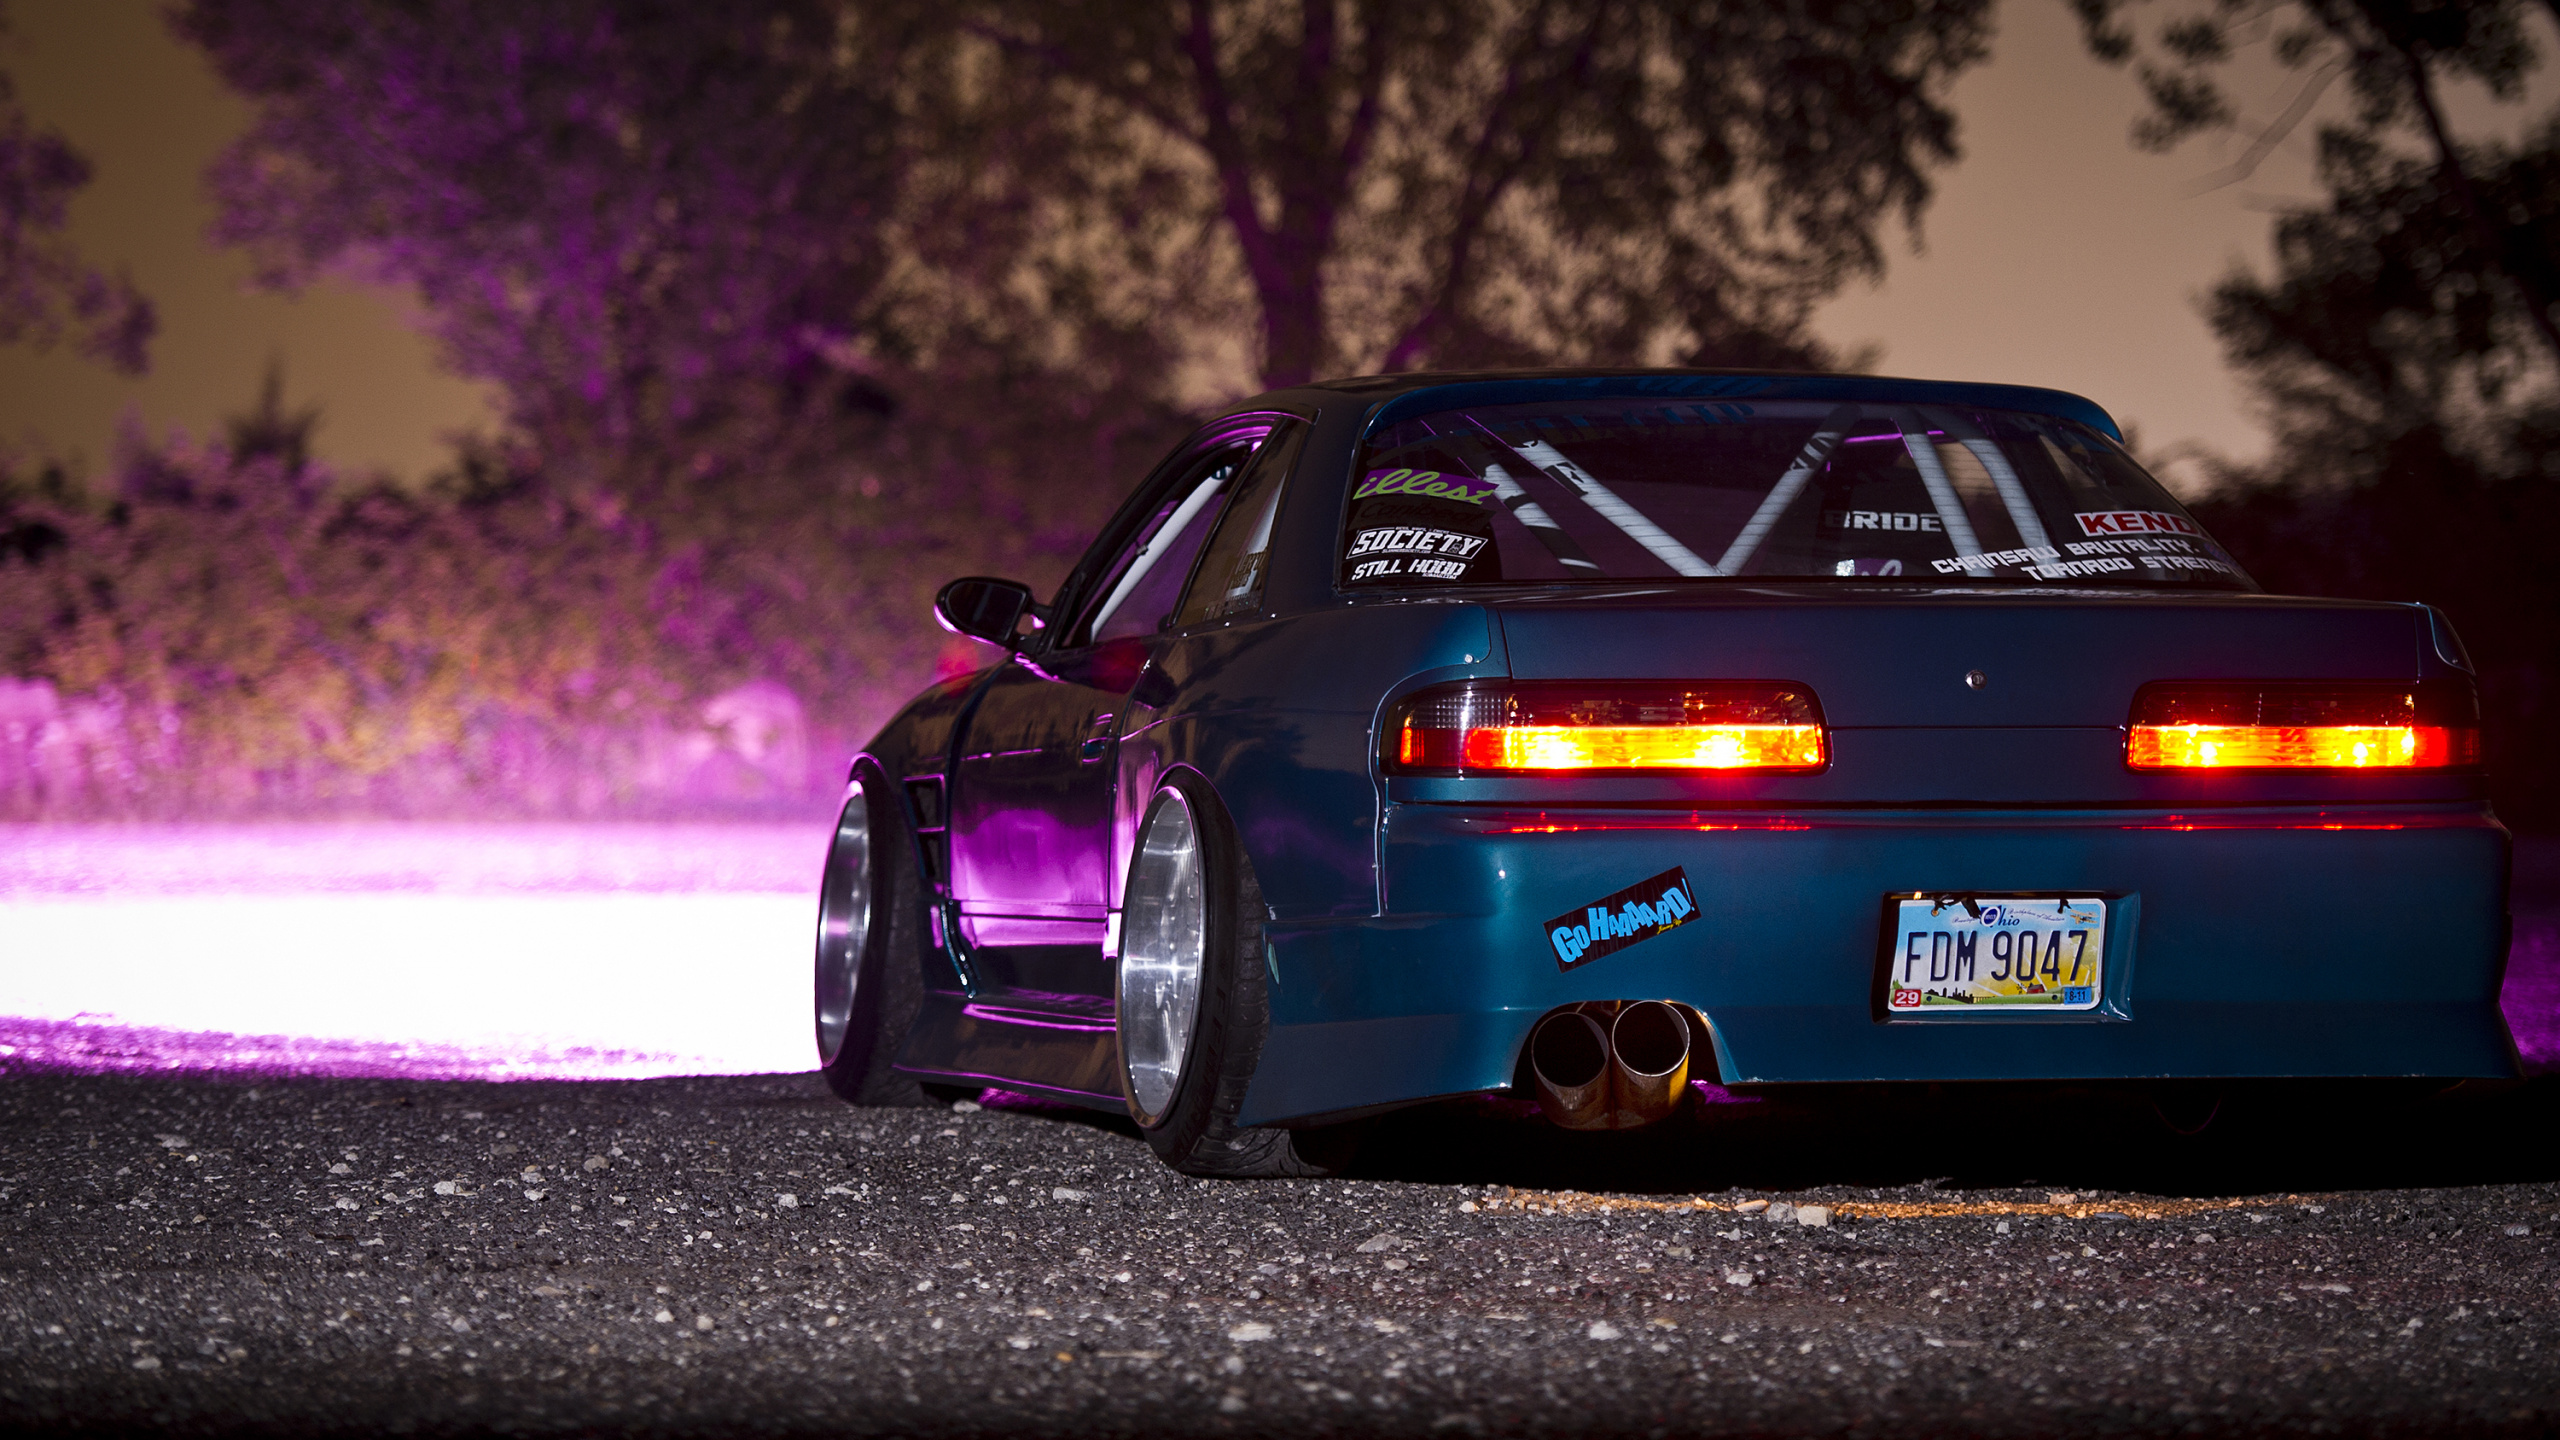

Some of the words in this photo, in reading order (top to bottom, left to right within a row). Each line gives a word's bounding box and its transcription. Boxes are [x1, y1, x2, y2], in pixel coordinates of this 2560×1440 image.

[1352, 468, 1495, 505] illest
[1824, 509, 1943, 532] BRIDE
[2080, 512, 2207, 537] KEND
[1352, 529, 1482, 556] SOCIETY
[1931, 545, 2062, 574] CHAINSAW
[2065, 538, 2200, 556] BRUTALITY.
[1351, 559, 1402, 581] STILL
[2021, 556, 2136, 582] TORNADO
[1980, 906, 2021, 927] Ohio
[1904, 930, 1978, 983] FDM
[1991, 930, 2089, 982] 9047
[1895, 991, 1920, 1006] 29
